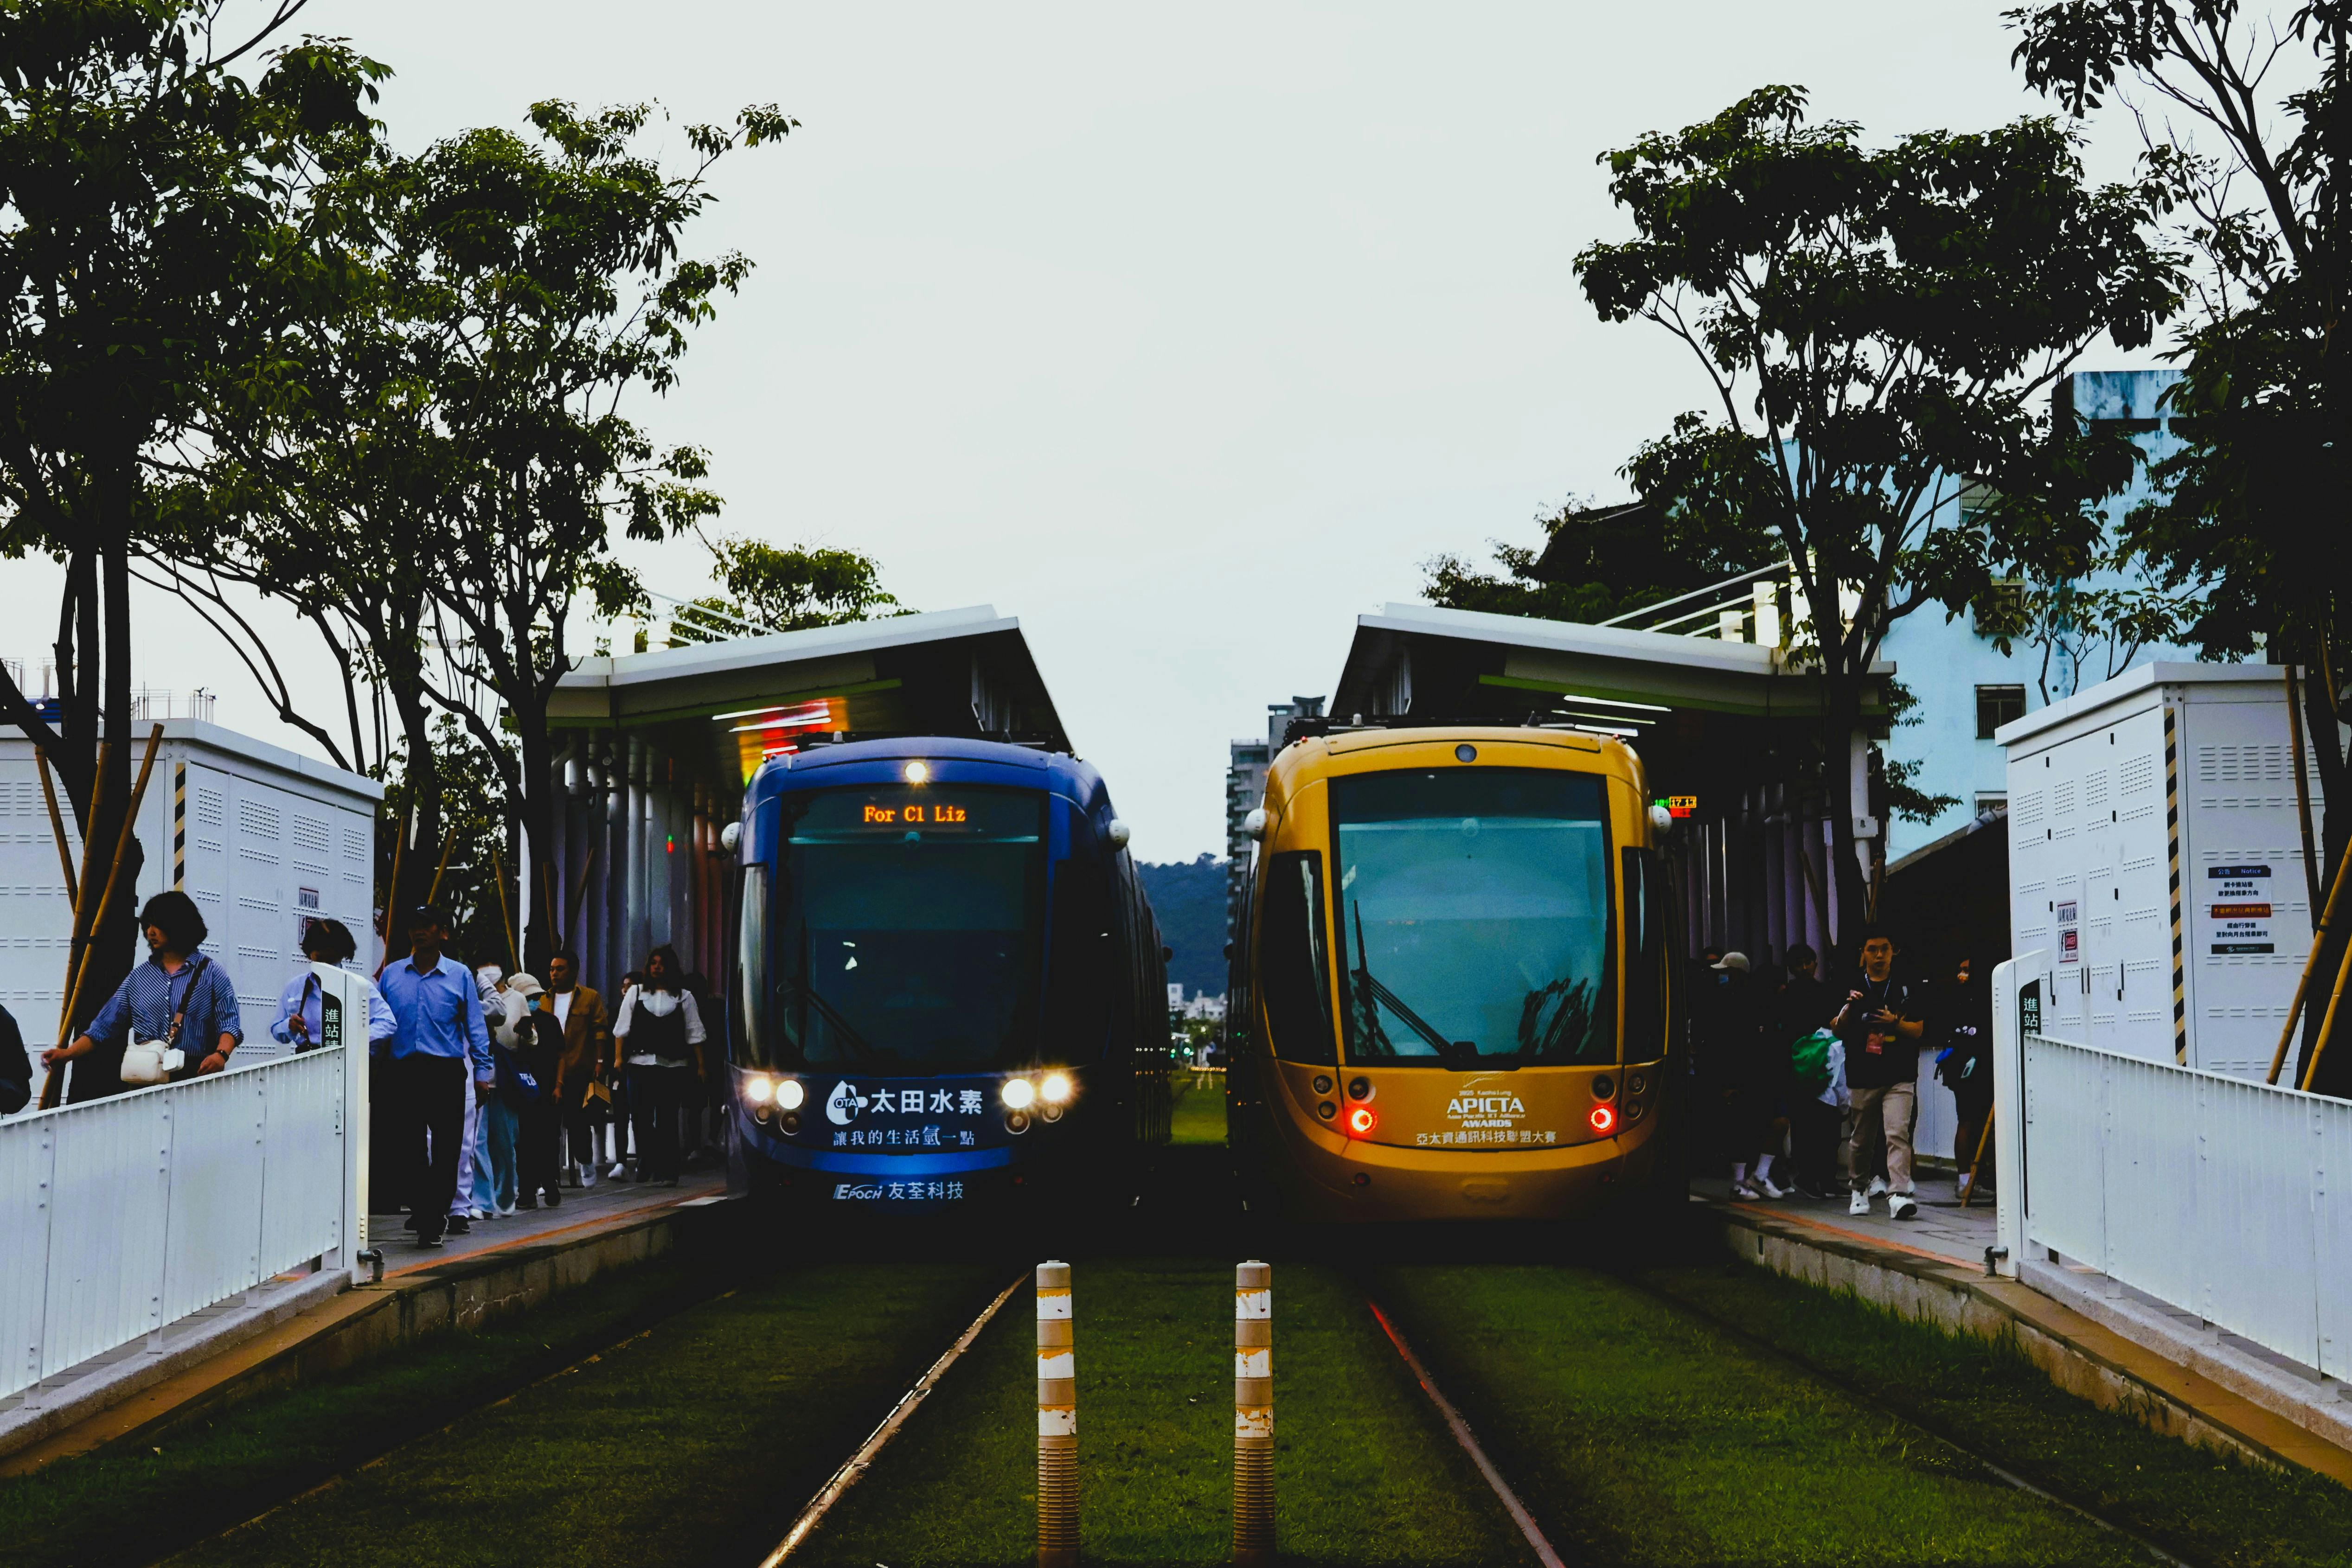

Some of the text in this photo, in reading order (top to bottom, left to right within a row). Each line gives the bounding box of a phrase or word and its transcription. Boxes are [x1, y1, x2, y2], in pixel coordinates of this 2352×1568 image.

[864, 805, 896, 822] For
[935, 805, 966, 822] Liz
[835, 1098, 858, 1108] OTA
[871, 1088, 983, 1114] 太田水素
[1447, 1097, 1525, 1114] APICTA
[1461, 1119, 1512, 1128] AWARDS
[833, 1125, 974, 1146] 讓我的生活氫一點
[888, 1181, 964, 1200] 友荃科技
